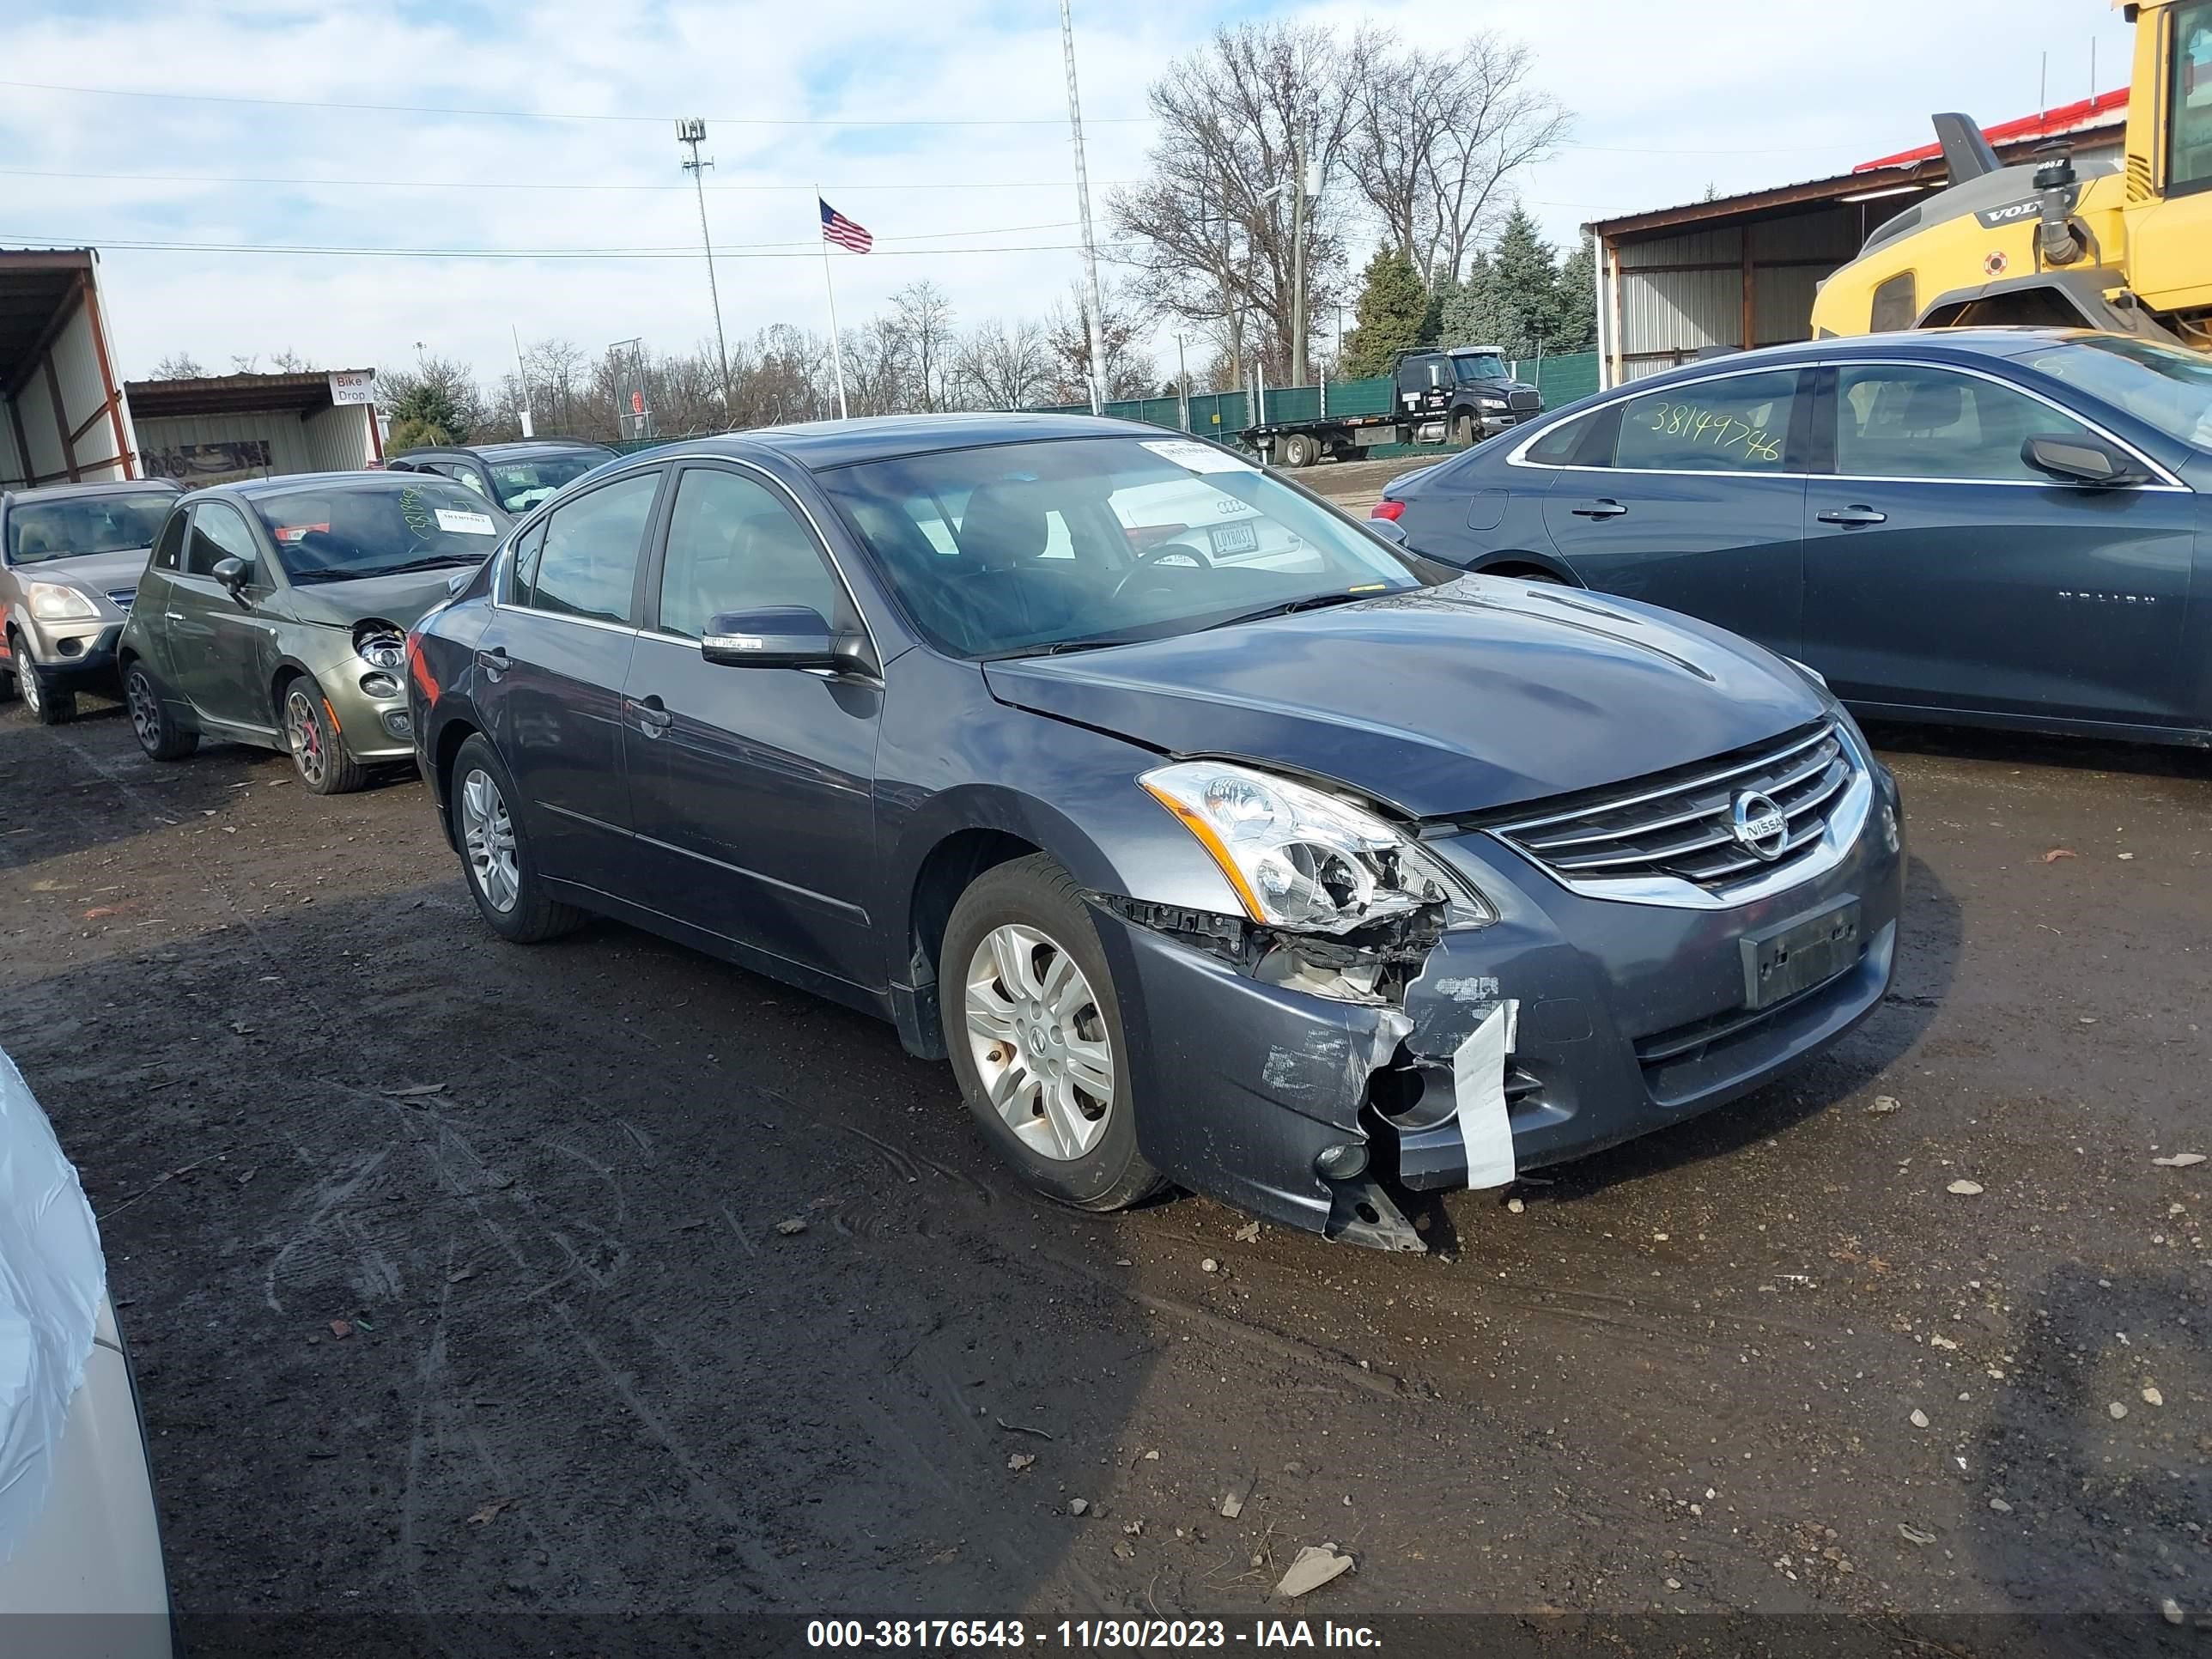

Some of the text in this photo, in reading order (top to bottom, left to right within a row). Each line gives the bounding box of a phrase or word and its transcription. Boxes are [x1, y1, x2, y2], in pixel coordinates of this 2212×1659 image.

[337, 376, 362, 386] Bike
[338, 391, 365, 402] Drop
[1651, 402, 1781, 461] 38149746
